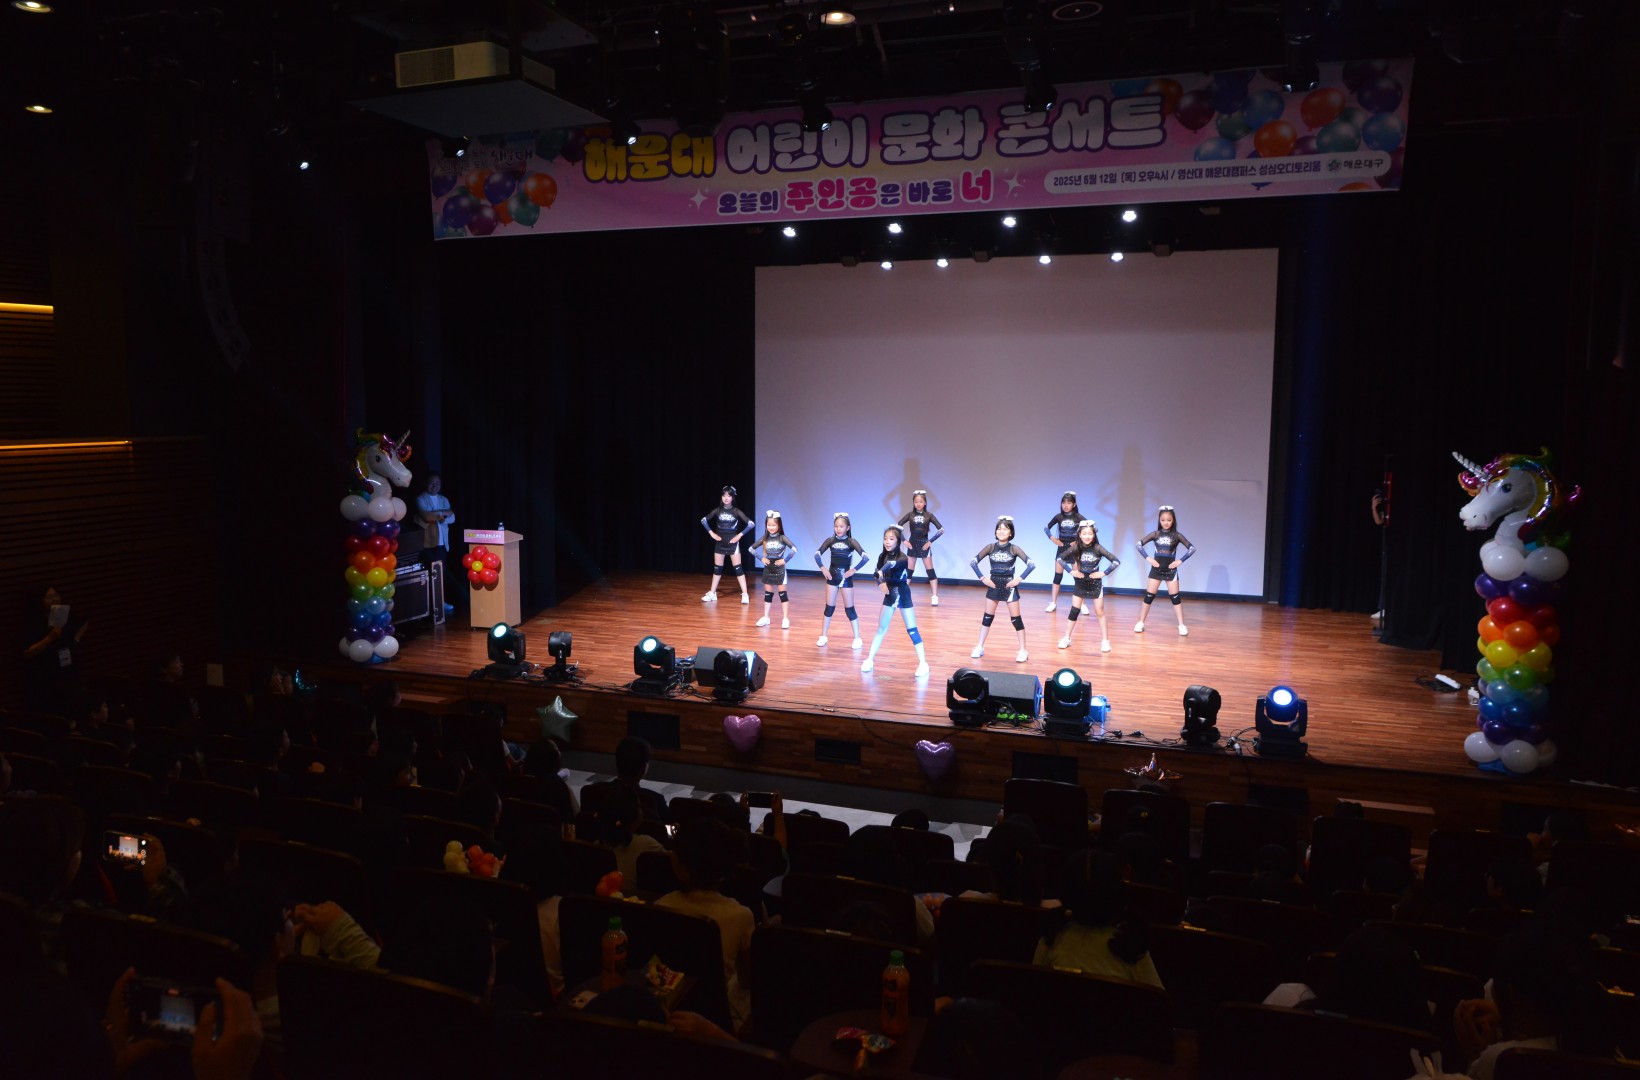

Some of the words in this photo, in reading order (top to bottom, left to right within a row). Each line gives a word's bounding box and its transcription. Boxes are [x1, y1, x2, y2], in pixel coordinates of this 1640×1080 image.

[583, 132, 716, 183] 해운대
[725, 115, 869, 174] 어린이
[881, 105, 988, 165] 문화
[995, 94, 1167, 158] 콘서트
[1053, 175, 1082, 186] 2025년
[1084, 173, 1097, 185] 6월
[1100, 172, 1117, 184] 12일
[1138, 169, 1169, 182] 오후4시
[1178, 167, 1202, 180] 영산대
[1343, 158, 1384, 169] 해운대구
[718, 189, 779, 213] 오늘의
[786, 176, 901, 212] 주인공은
[908, 180, 953, 204] 바로
[961, 168, 993, 201] 너
